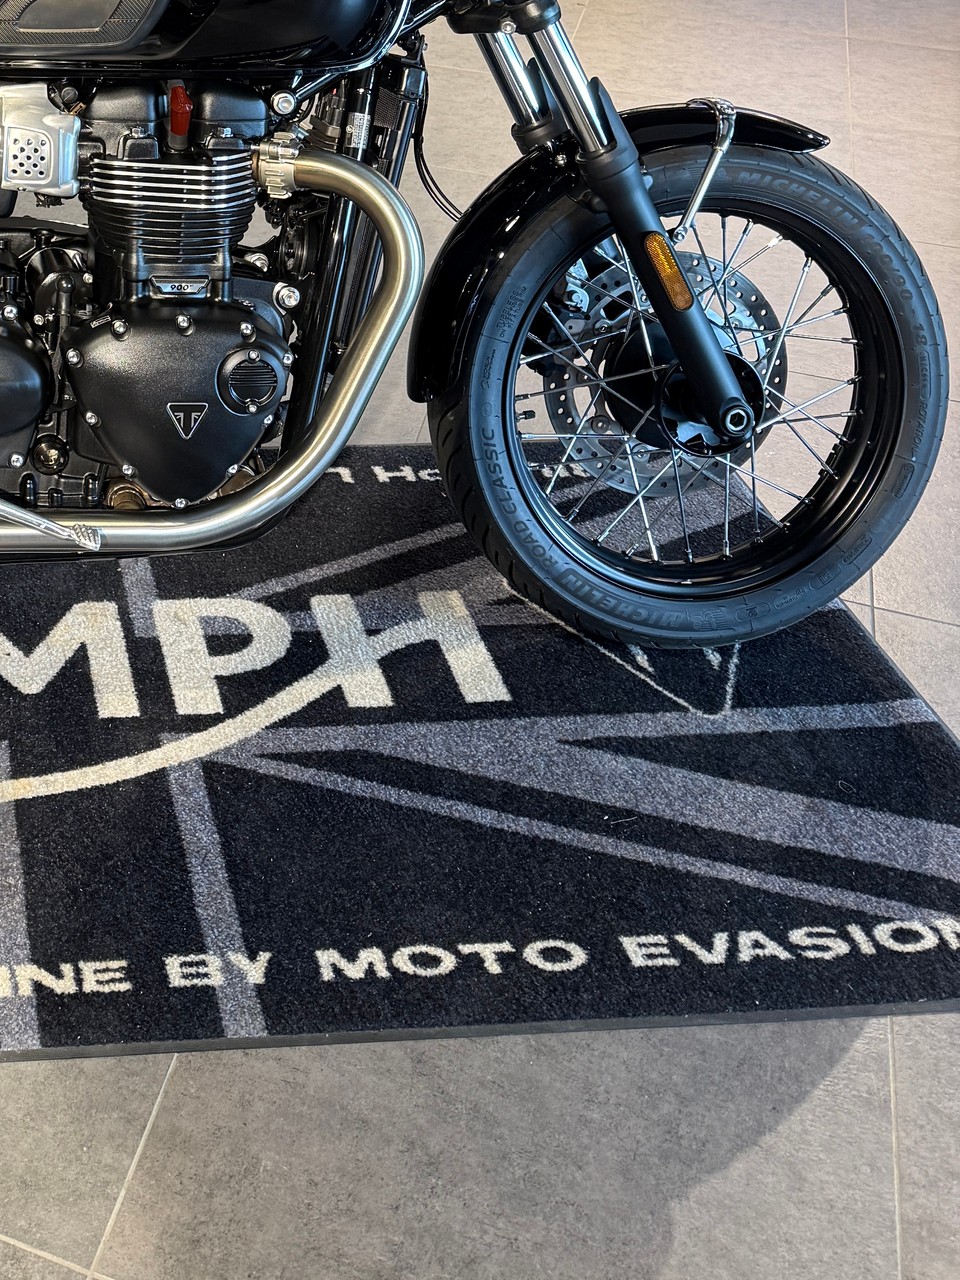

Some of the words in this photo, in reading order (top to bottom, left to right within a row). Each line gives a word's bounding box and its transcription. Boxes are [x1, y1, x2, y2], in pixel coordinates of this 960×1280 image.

[736, 171, 860, 226] MICHELIN
[912, 399, 928, 453] ROTATION
[480, 427, 518, 518] CLASSIC
[512, 519, 559, 570] ROAD
[560, 569, 684, 628] MICHELIN
[164, 949, 272, 991] BY
[318, 938, 588, 983] MOTO
